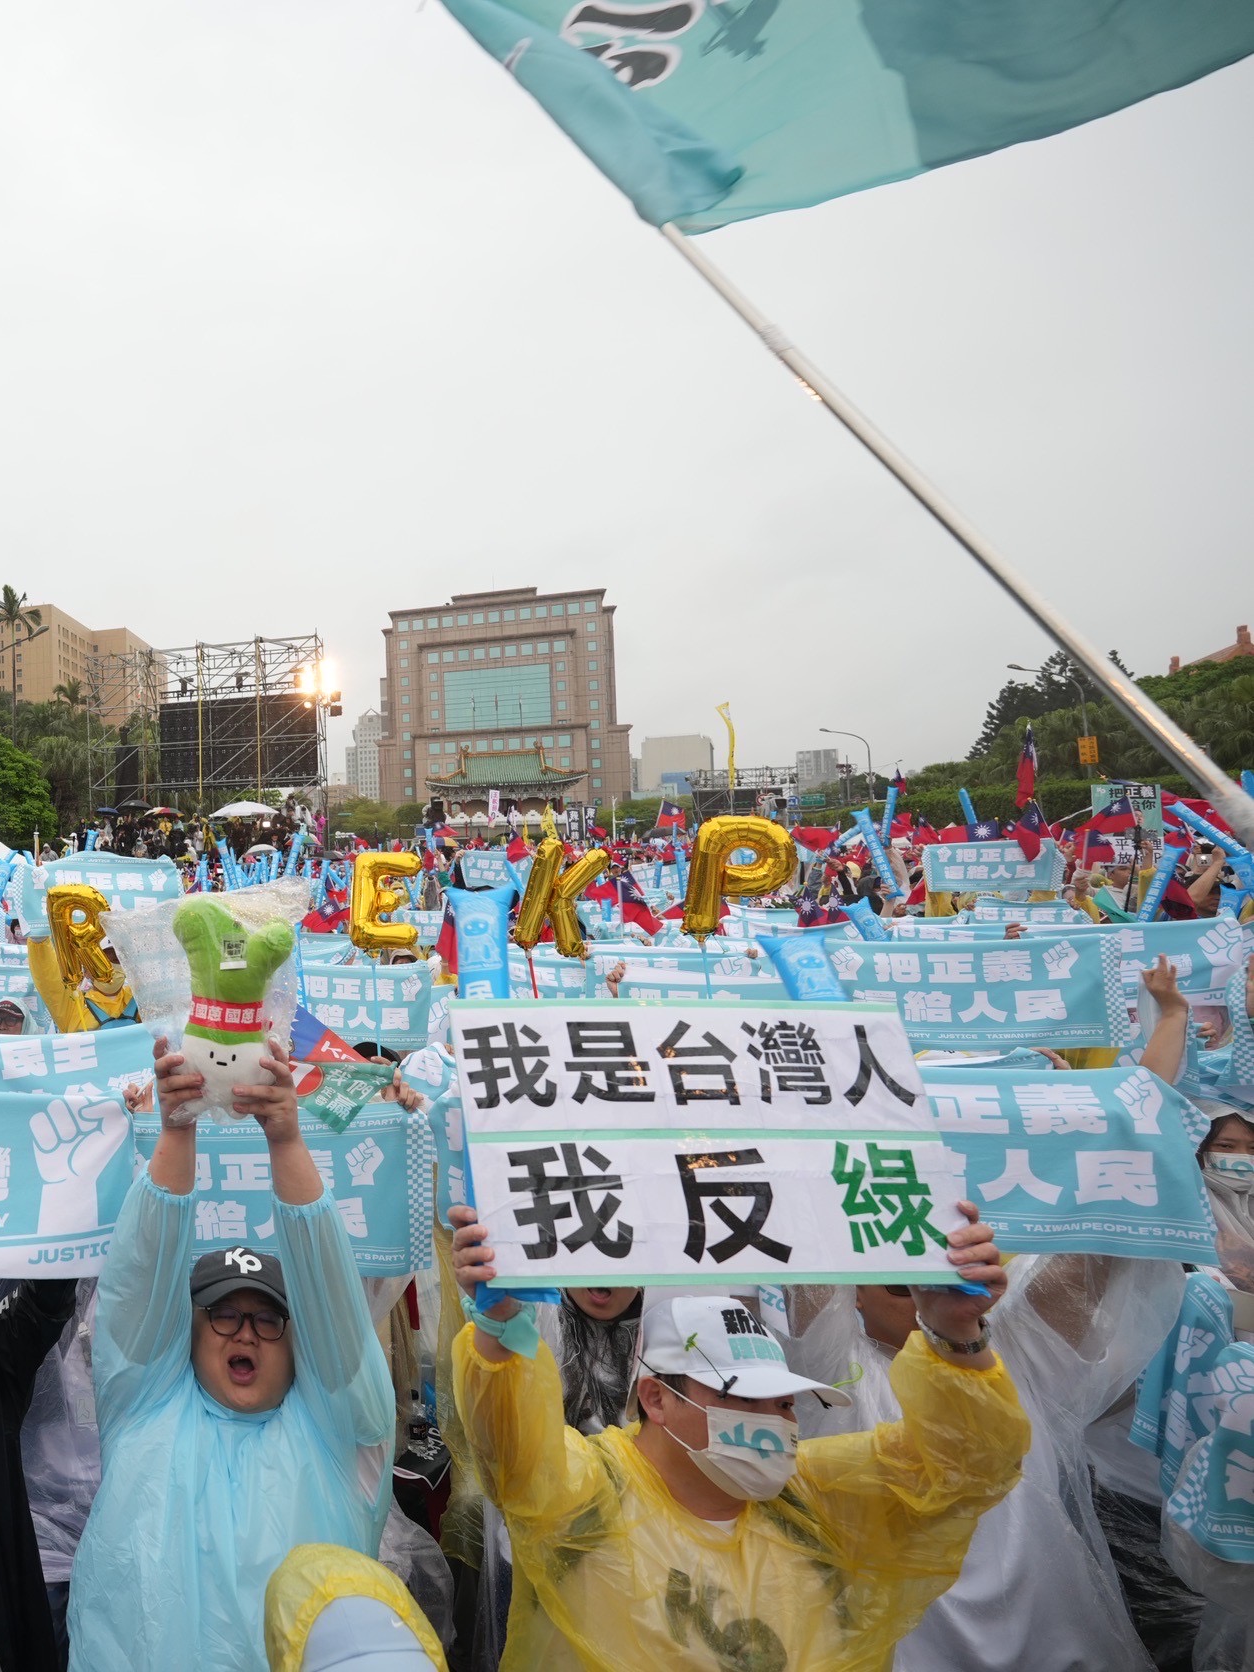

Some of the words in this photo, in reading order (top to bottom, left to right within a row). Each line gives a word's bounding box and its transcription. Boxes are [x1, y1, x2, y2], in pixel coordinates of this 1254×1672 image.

[945, 864, 1036, 880] 還給人民
[1138, 871, 1167, 923] 民主國家政治
[873, 950, 1033, 984] 把正義
[309, 1003, 411, 1031] 給人民
[1024, 1030, 1069, 1038] PEOPLE'S
[1070, 1028, 1105, 1037] PARTY
[462, 1019, 917, 1109] 我是台灣人
[367, 1116, 403, 1128] PARTY
[949, 1148, 1159, 1206] 人民
[507, 1140, 948, 1264] 我反綠
[1023, 1222, 1081, 1232] TAIWAN
[1082, 1222, 1163, 1237] PEOPLE'S
[28, 1240, 111, 1266] JUSTIC
[225, 1247, 262, 1273] KP
[372, 1253, 405, 1261] PARTY
